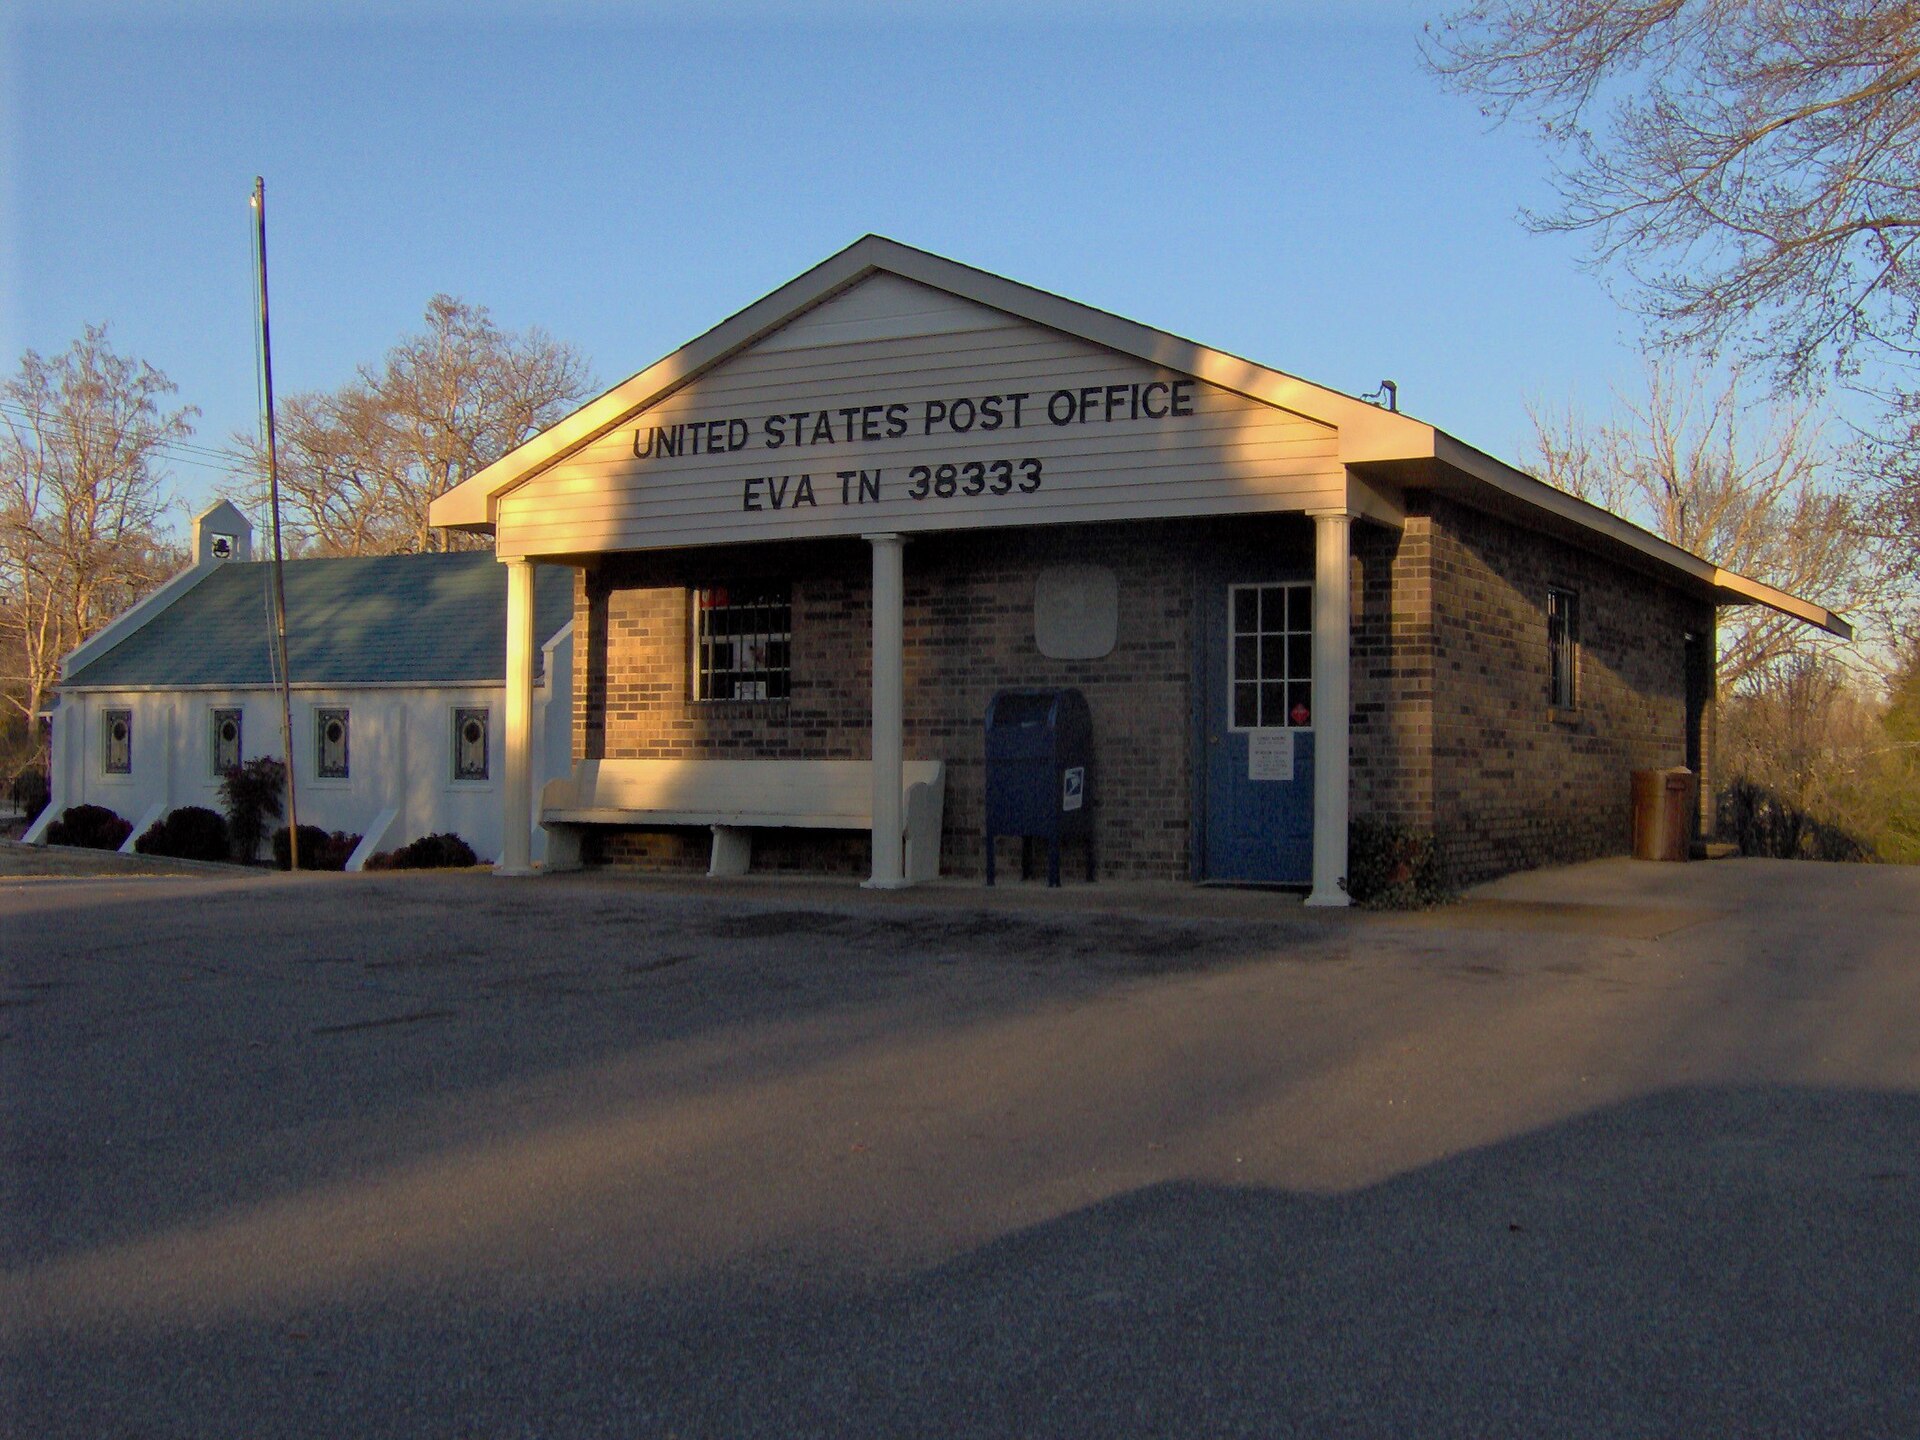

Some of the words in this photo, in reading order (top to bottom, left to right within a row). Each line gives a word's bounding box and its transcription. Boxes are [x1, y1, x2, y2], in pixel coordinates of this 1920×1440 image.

[633, 418, 748, 459] UNITED
[765, 402, 908, 450] STATES
[924, 393, 1029, 435] POST
[1047, 380, 1195, 427] OFFICE
[743, 474, 817, 512] EVA
[837, 469, 882, 505] TN
[908, 458, 1043, 500] 38333
